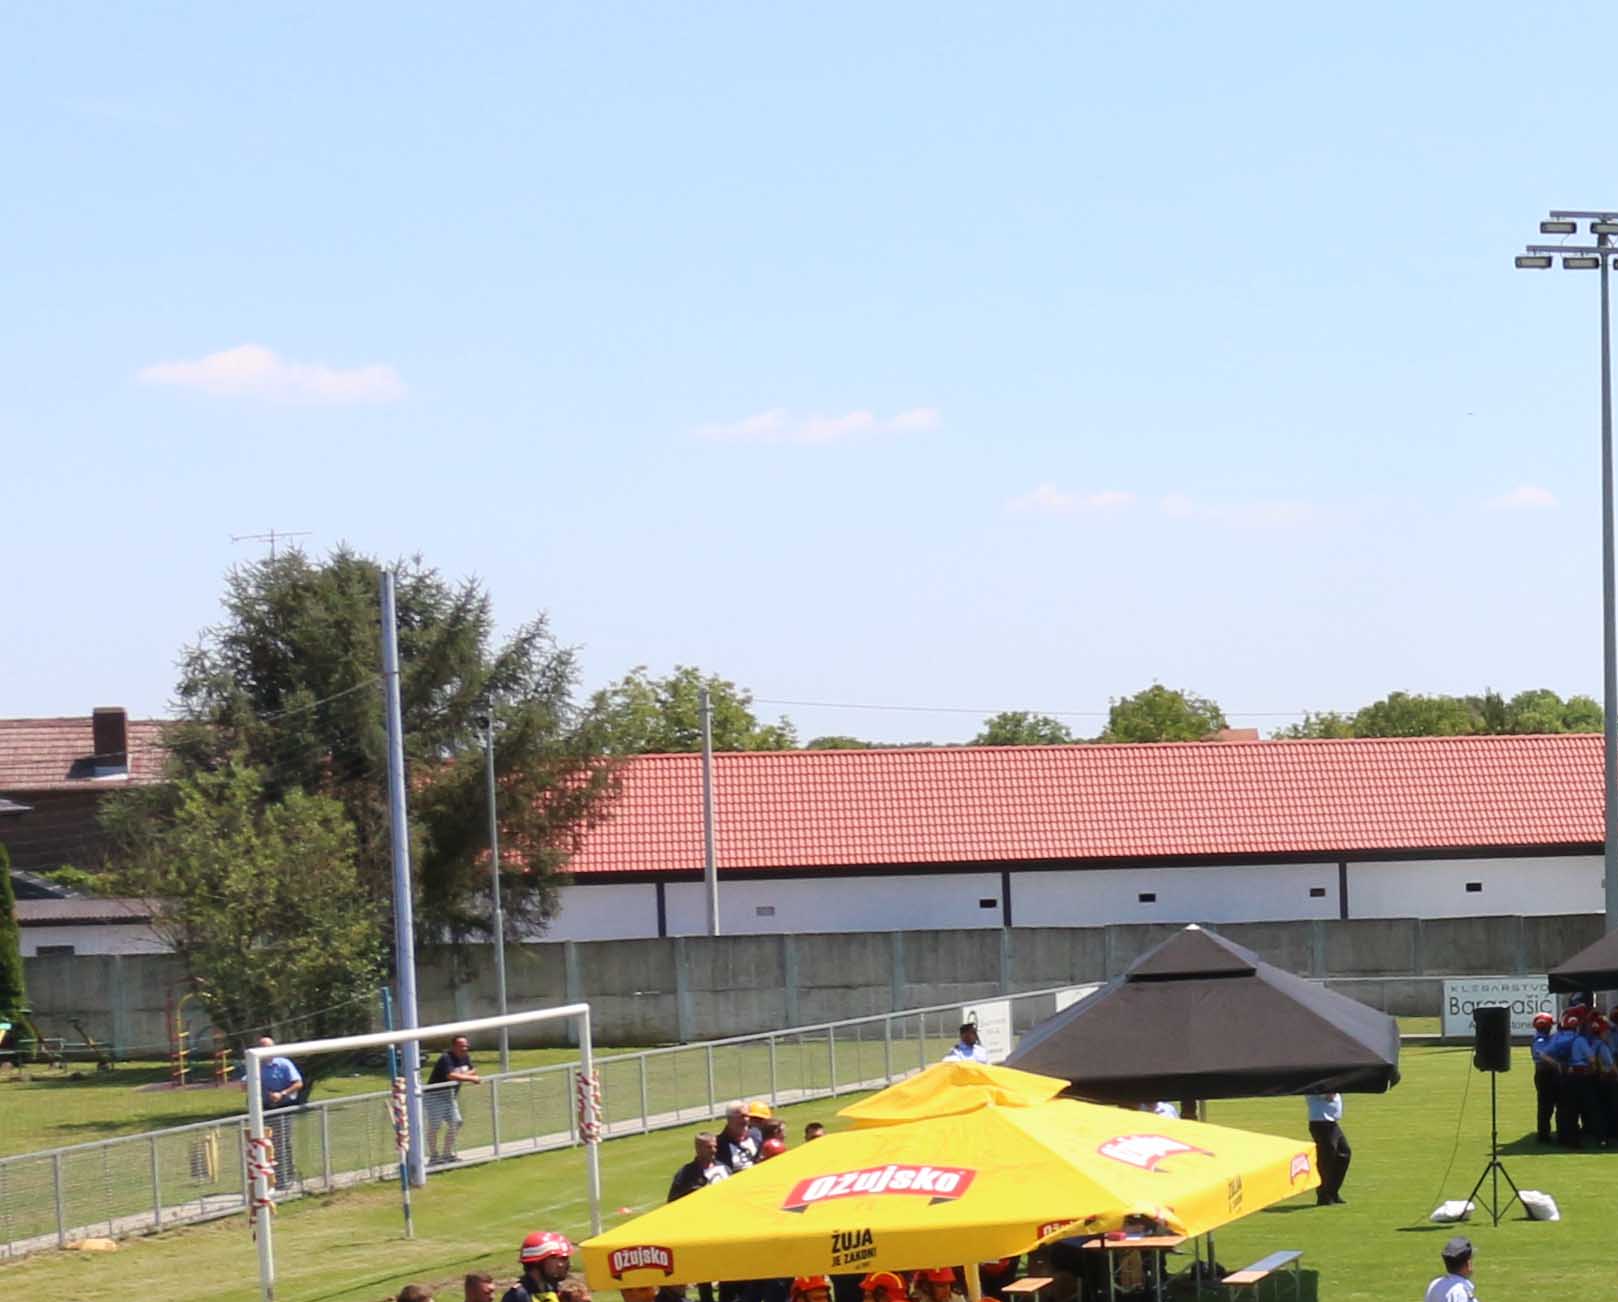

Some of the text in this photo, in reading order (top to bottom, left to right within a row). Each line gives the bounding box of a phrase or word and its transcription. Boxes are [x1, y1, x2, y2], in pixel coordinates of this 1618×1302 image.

[802, 1164, 961, 1201] Ožujsko
[831, 1228, 873, 1254] ŽUJA
[613, 1246, 669, 1272] Ožujsko
[832, 1256, 841, 1268] JE
